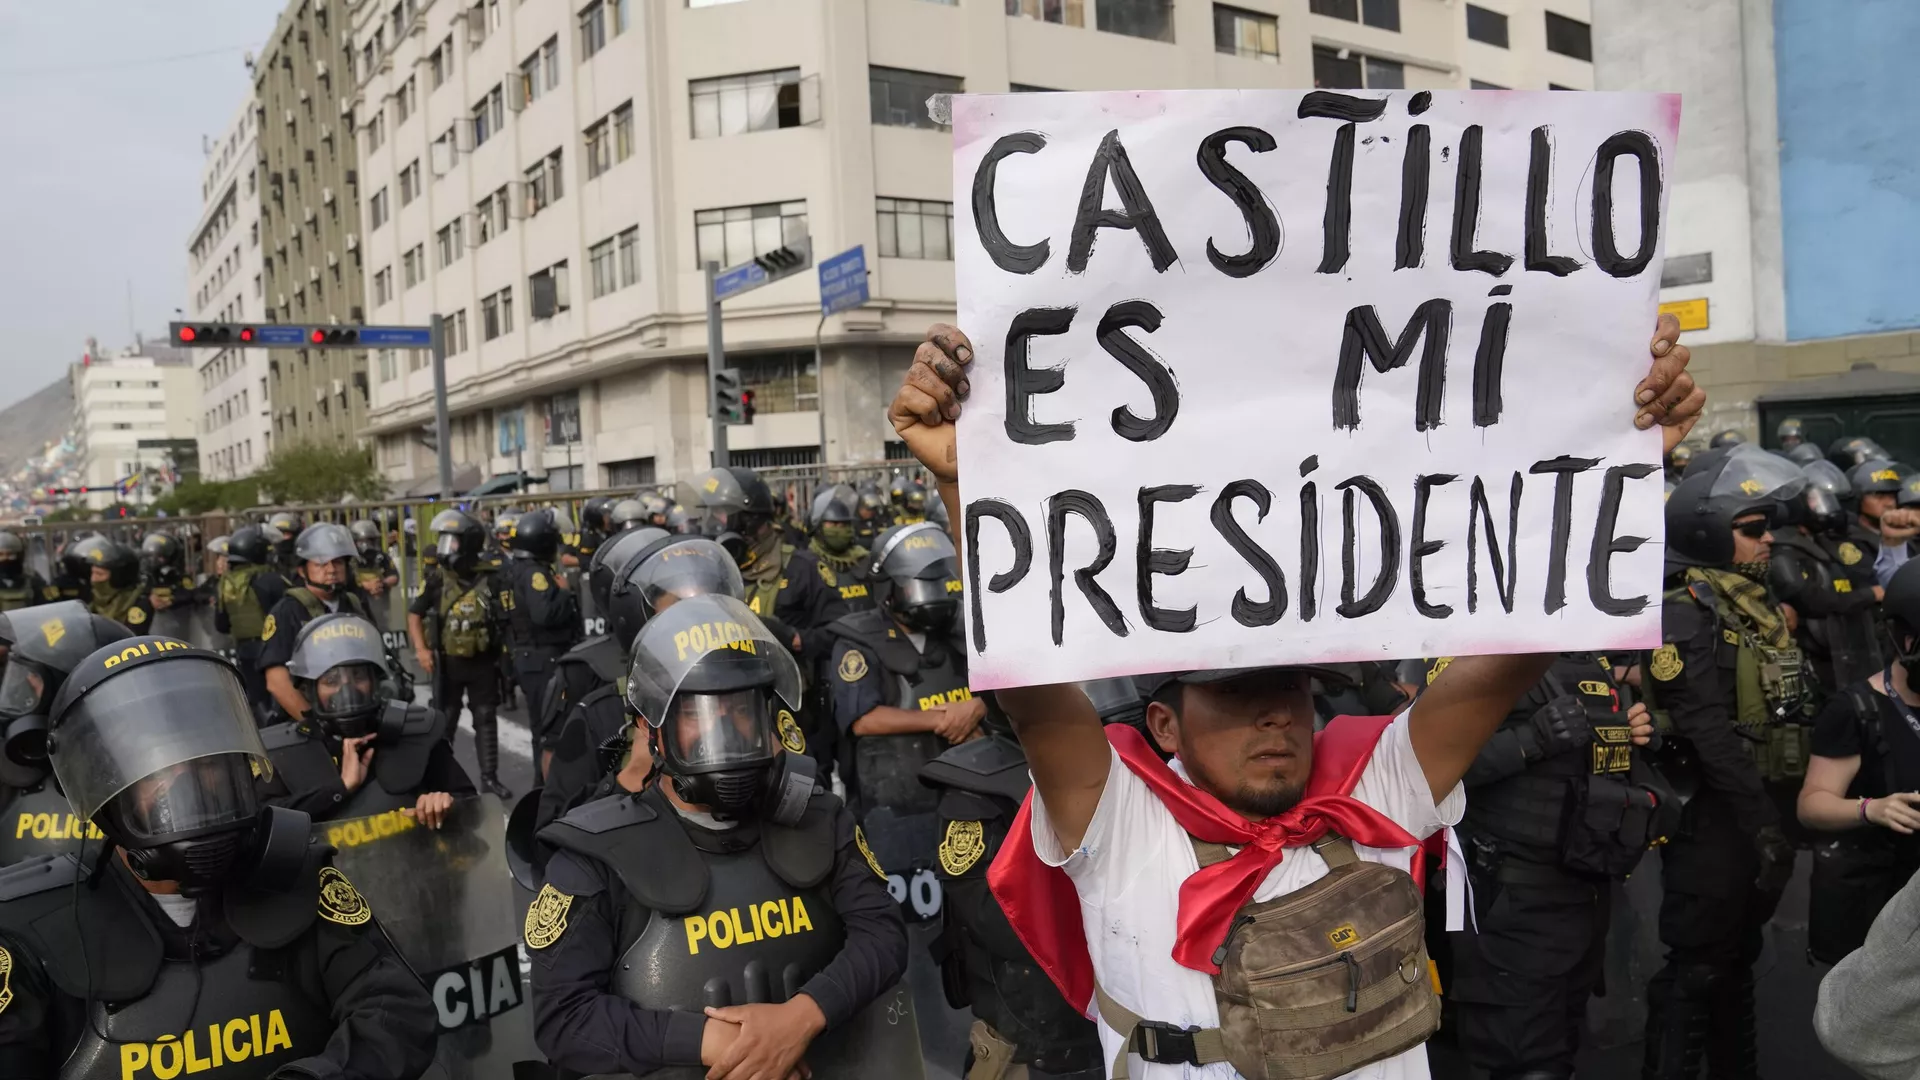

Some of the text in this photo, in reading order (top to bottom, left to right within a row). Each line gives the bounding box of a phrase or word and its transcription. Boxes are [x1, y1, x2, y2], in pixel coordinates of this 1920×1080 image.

[1004, 298, 1182, 446] ES
[312, 622, 367, 645] POLICIA
[674, 621, 757, 661] POLICIA
[327, 807, 416, 848] POLICIA
[684, 896, 814, 956] POLICIA
[1331, 928, 1352, 943] CAT
[120, 1009, 293, 1080] POLICIA
